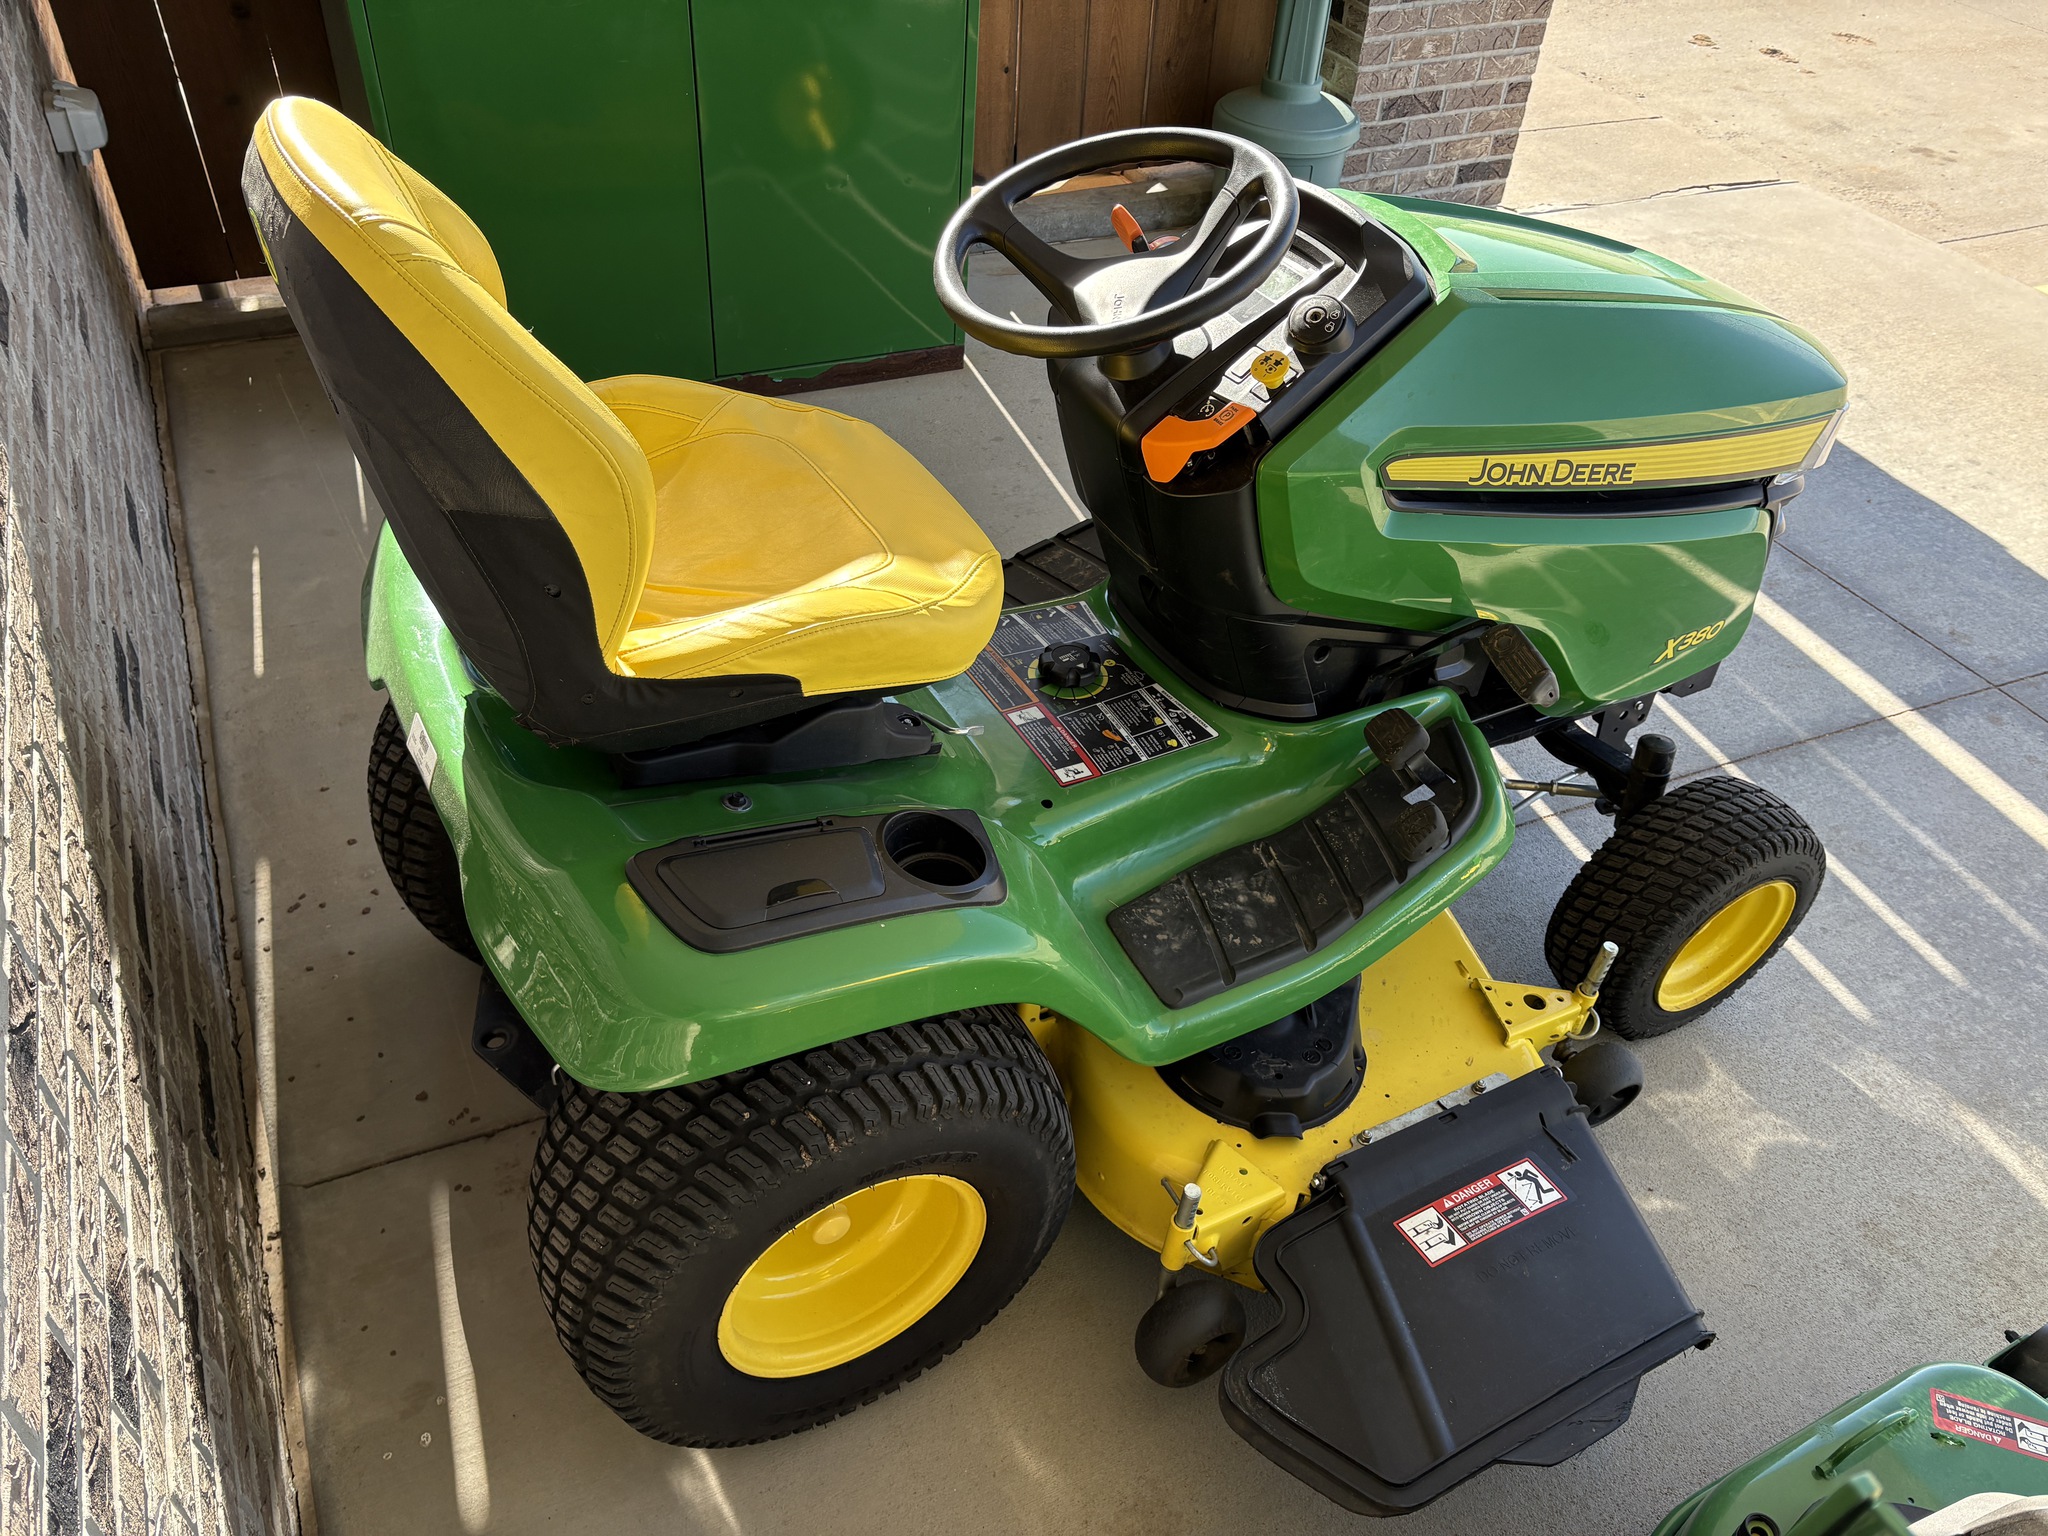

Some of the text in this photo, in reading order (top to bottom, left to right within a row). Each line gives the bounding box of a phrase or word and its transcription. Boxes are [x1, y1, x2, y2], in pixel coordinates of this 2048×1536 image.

[1468, 457, 1636, 485] JOHN DEERE
[1652, 620, 1726, 664] X380
[1059, 729, 1077, 748] DANGER
[1450, 1178, 1494, 1203] DANGER
[1452, 1189, 1495, 1211] ROTATING BLADE
[1461, 1197, 1505, 1221] THROWN OBJECTS
[1948, 1414, 2005, 1436] ROTATING BLADE
[1954, 1424, 1991, 1441] DANGER
